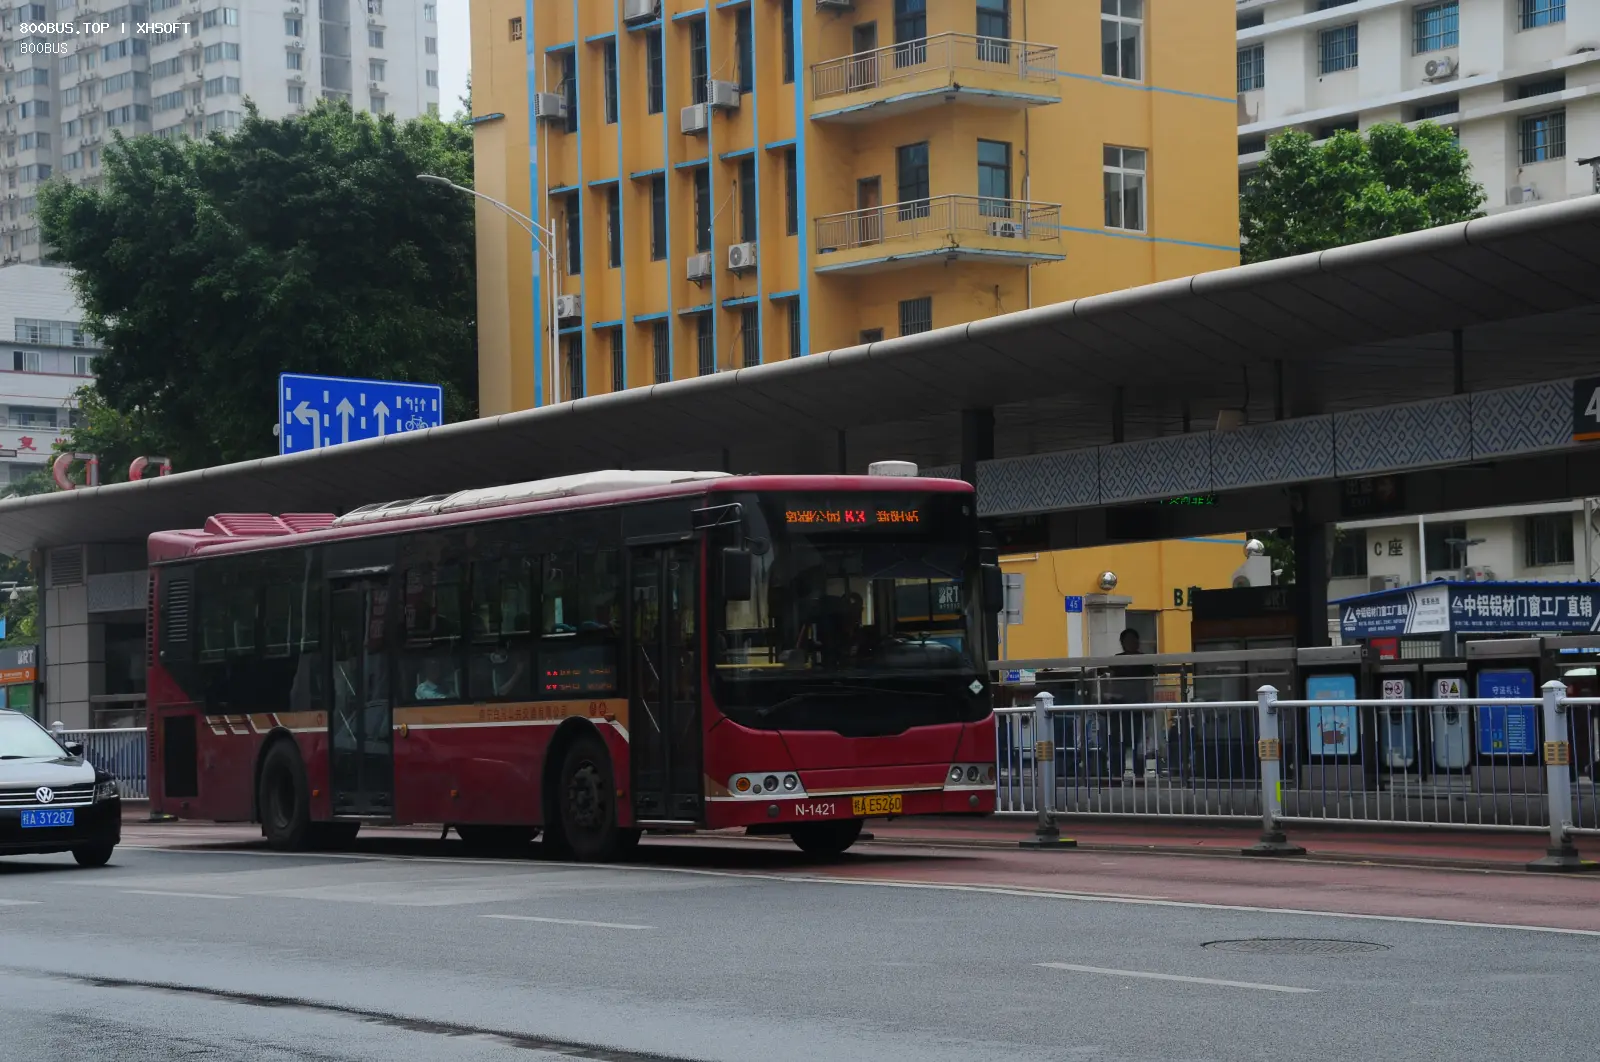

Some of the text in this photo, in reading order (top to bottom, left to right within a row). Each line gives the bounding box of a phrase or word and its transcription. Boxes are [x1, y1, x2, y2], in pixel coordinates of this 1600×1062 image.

[1463, 594, 1593, 618] 中铝铝材门窗工厂直销
[795, 803, 835, 816] N-1421
